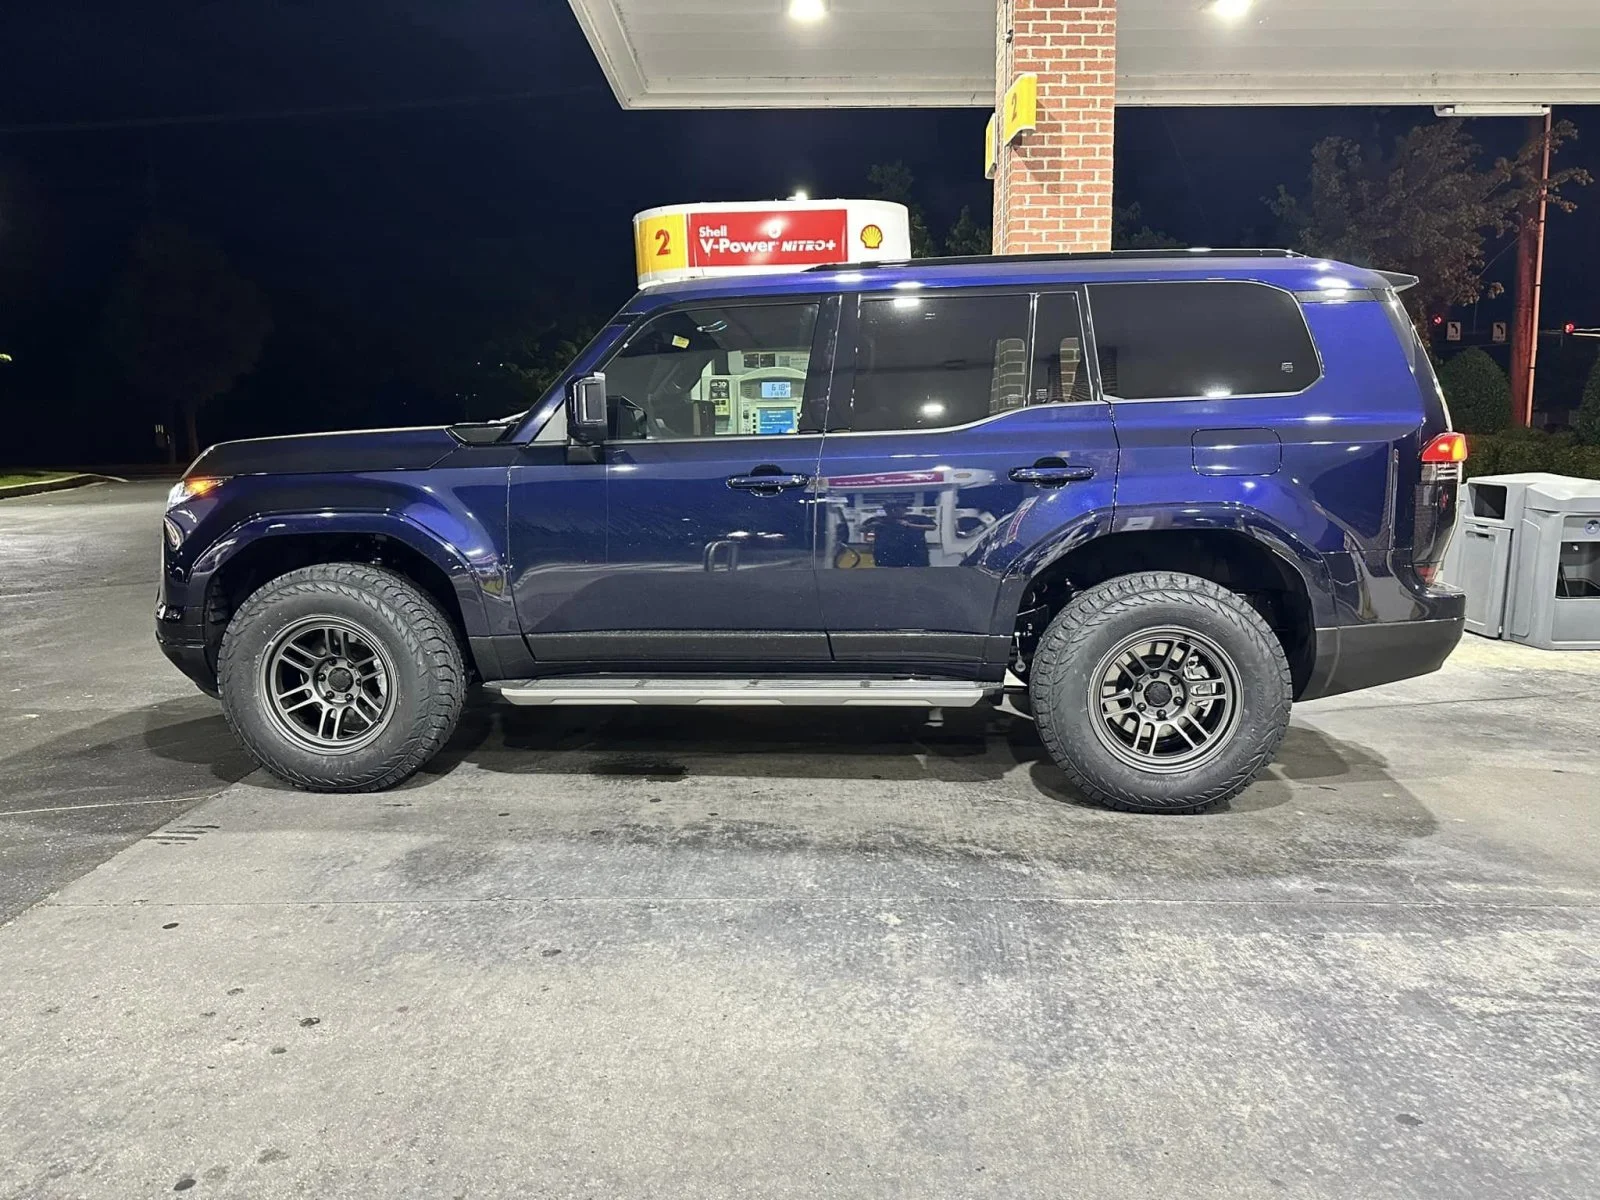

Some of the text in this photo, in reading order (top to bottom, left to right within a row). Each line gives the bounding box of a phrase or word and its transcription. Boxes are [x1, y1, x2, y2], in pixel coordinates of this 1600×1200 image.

[698, 225, 728, 237] Shell
[655, 229, 671, 256] 2
[699, 238, 776, 254] V-Power
